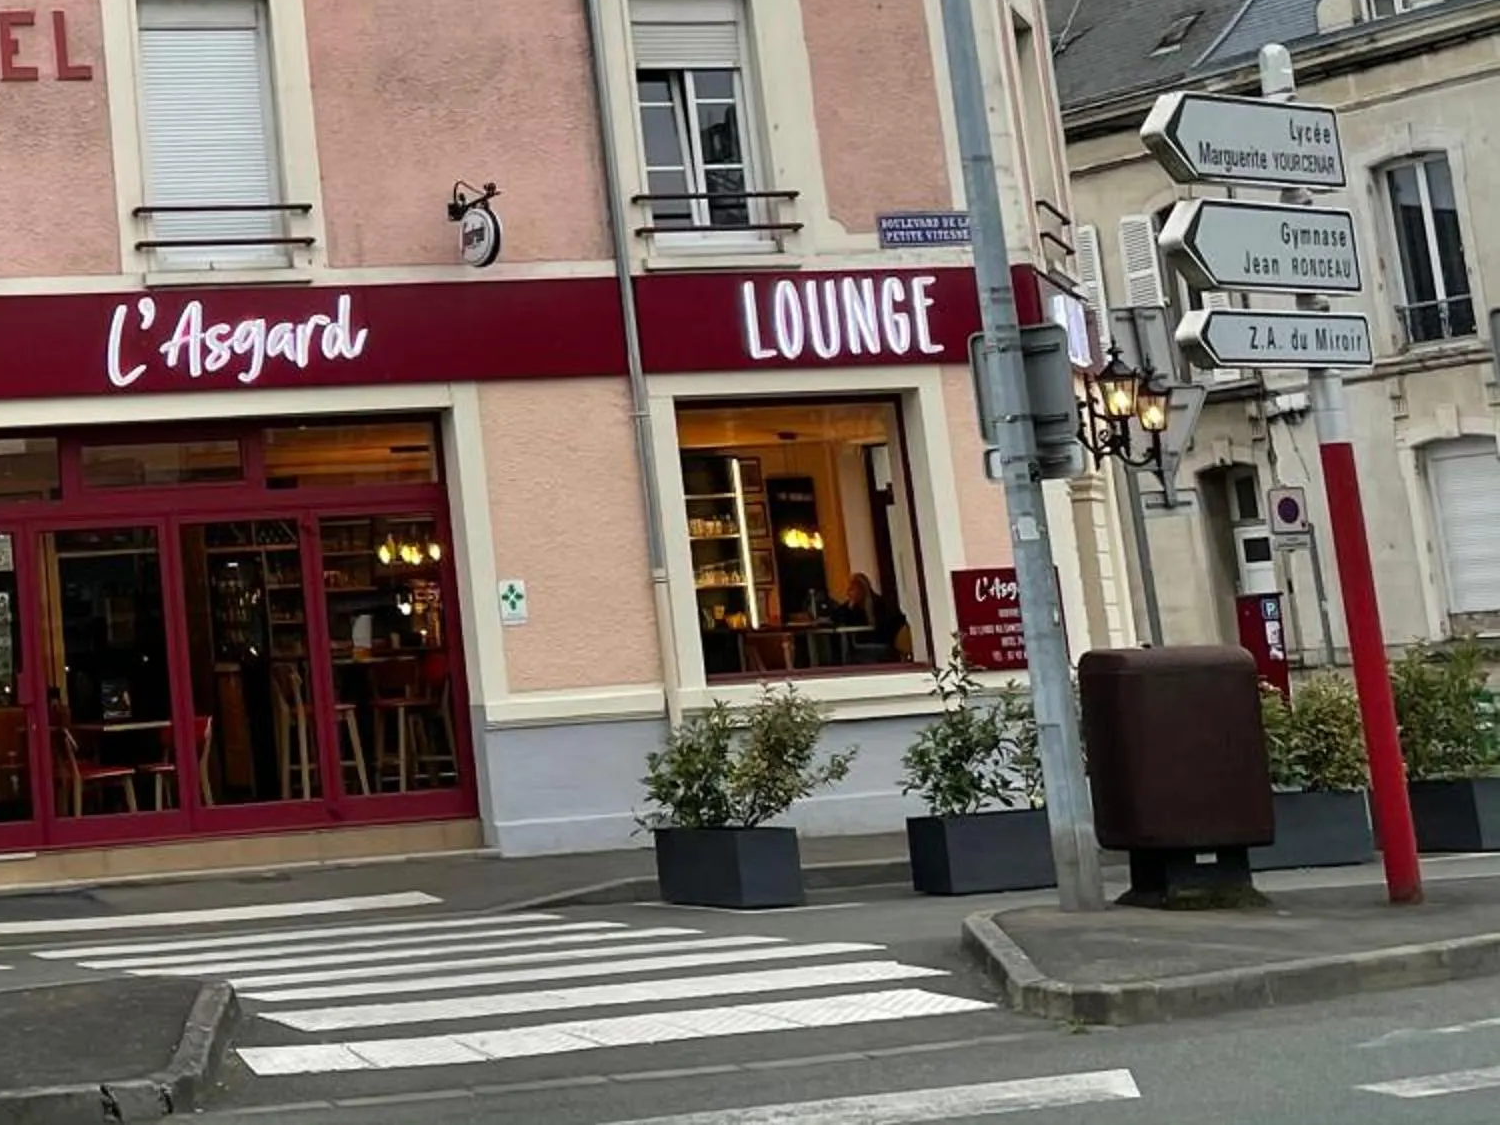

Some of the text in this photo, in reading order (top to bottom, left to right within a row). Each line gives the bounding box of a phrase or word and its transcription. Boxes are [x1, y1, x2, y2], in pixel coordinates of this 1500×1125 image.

[1289, 119, 1332, 147] Lycée
[1199, 140, 1336, 174] Marguerite YOURCENAR
[881, 217, 939, 229] BOULEVARD
[886, 230, 924, 242] PETITE
[1281, 222, 1347, 249] Gymnase
[1243, 249, 1351, 278] Jean RONDEAU
[743, 276, 945, 360] LOUNGE
[107, 294, 368, 387] L'Asgard
[1249, 326, 1363, 352] Z.A. du Miroir
